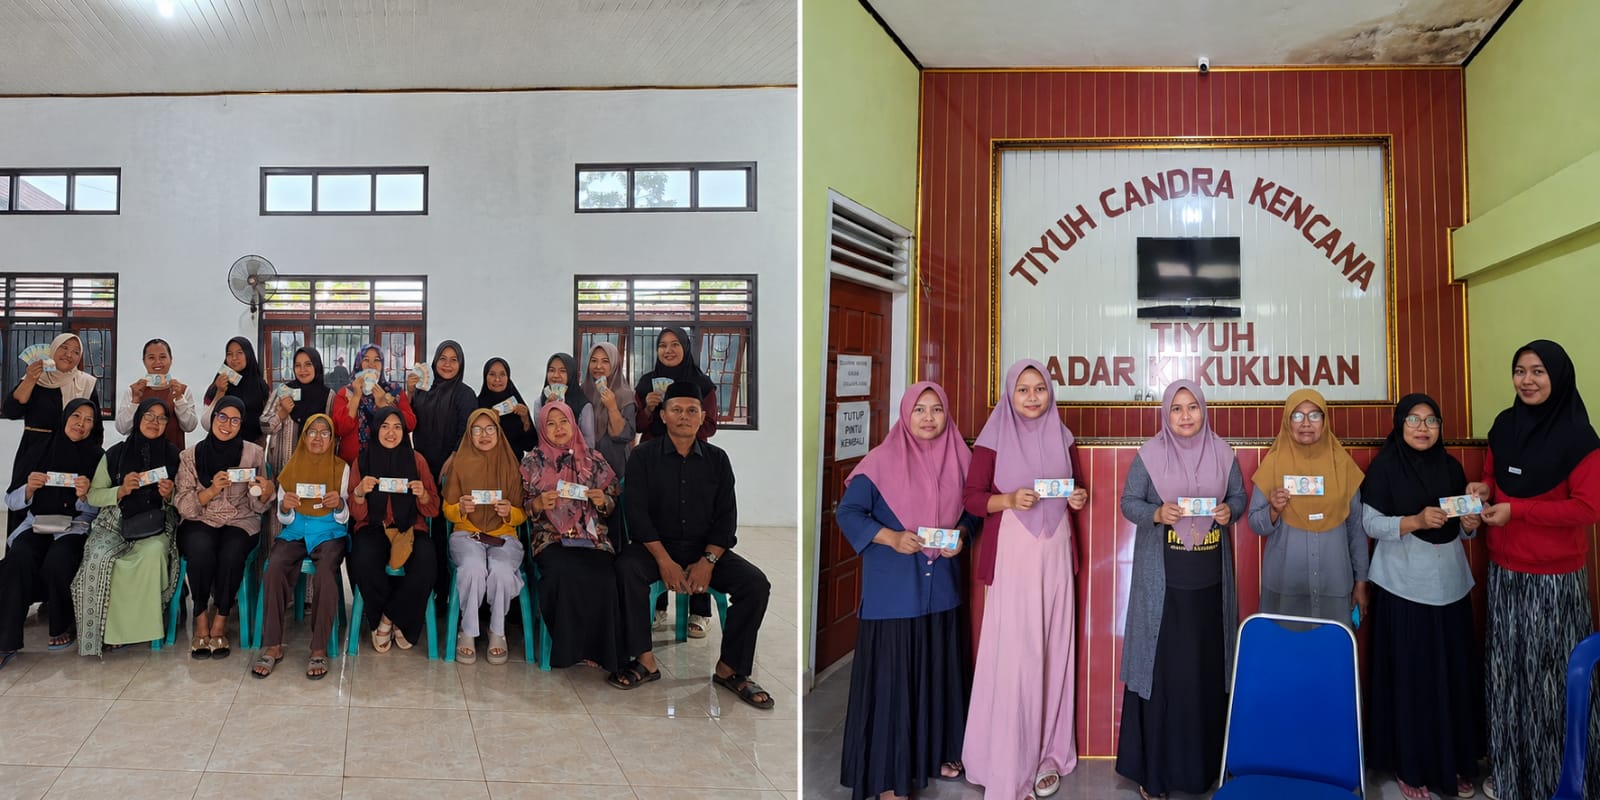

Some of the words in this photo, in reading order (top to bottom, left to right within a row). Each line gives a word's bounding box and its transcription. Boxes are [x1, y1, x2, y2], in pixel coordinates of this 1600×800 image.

[1009, 204, 1097, 286] TIYUH
[1099, 168, 1234, 218] CANDRA
[1248, 177, 1376, 292] KENCANA
[1151, 322, 1254, 352] TIYUH
[1150, 355, 1359, 386] KUKUKUNAN
[843, 411, 864, 420] TUTUP
[845, 425, 862, 434] PINTU
[841, 437, 864, 448] KEMBALI
